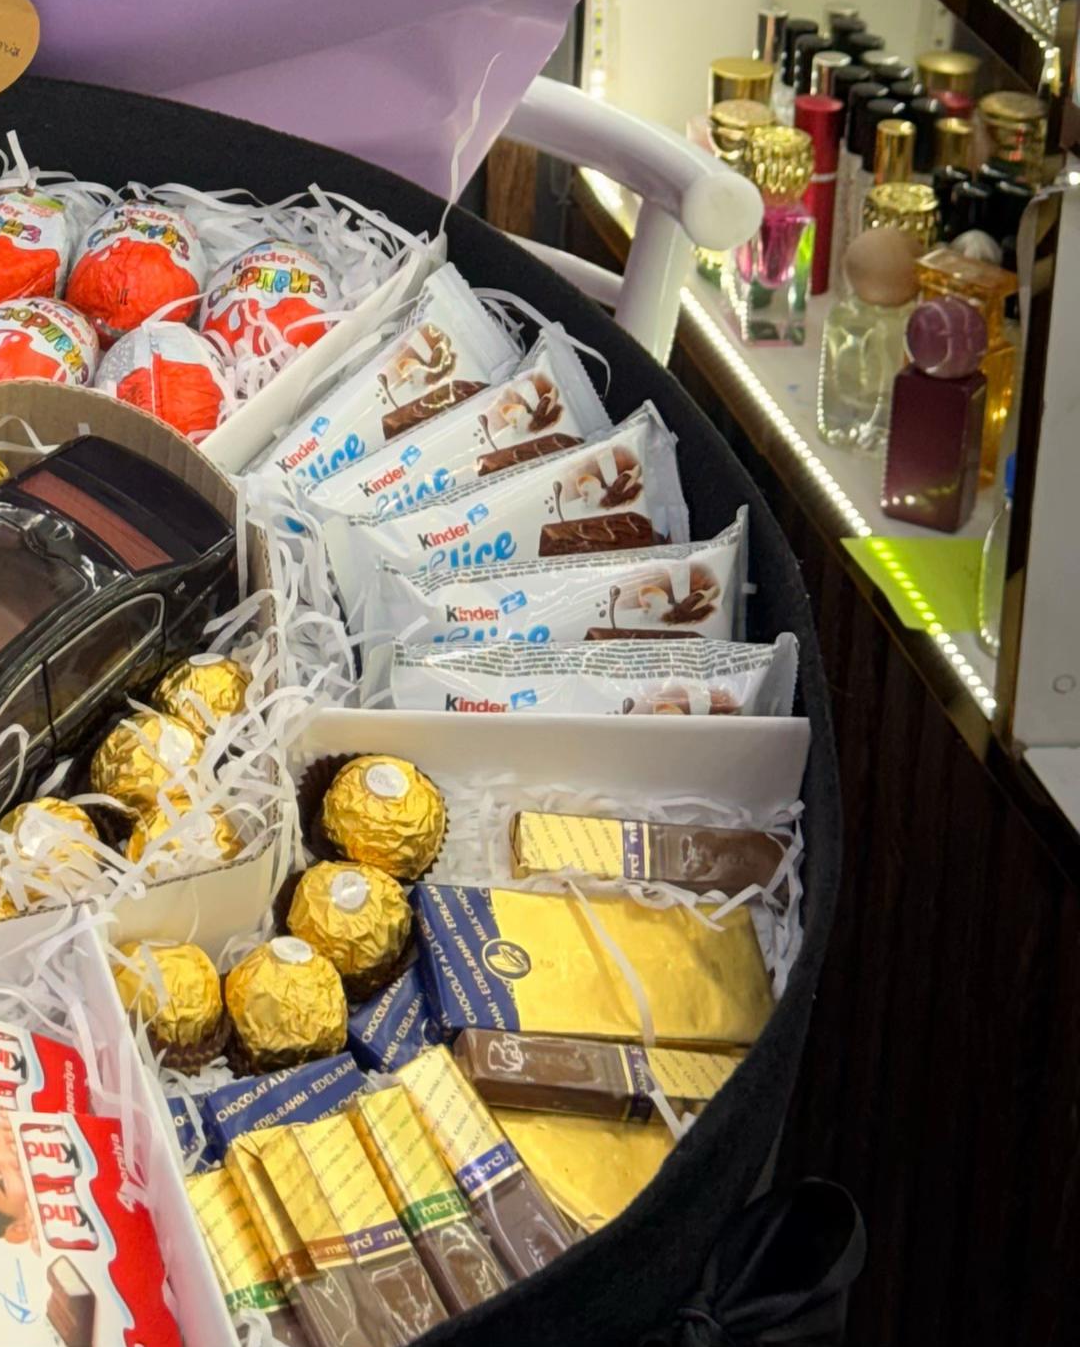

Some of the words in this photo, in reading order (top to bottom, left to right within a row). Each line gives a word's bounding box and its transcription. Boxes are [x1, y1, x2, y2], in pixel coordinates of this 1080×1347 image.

[275, 436, 320, 475] Kinder
[357, 464, 407, 498] Kinder
[417, 522, 471, 551] Kinder
[445, 605, 500, 623] Kinder
[444, 693, 509, 713] Kinder
[216, 1083, 269, 1123] CHOCOLAT
[23, 1139, 81, 1176] Kind
[39, 1203, 96, 1233] Kind
